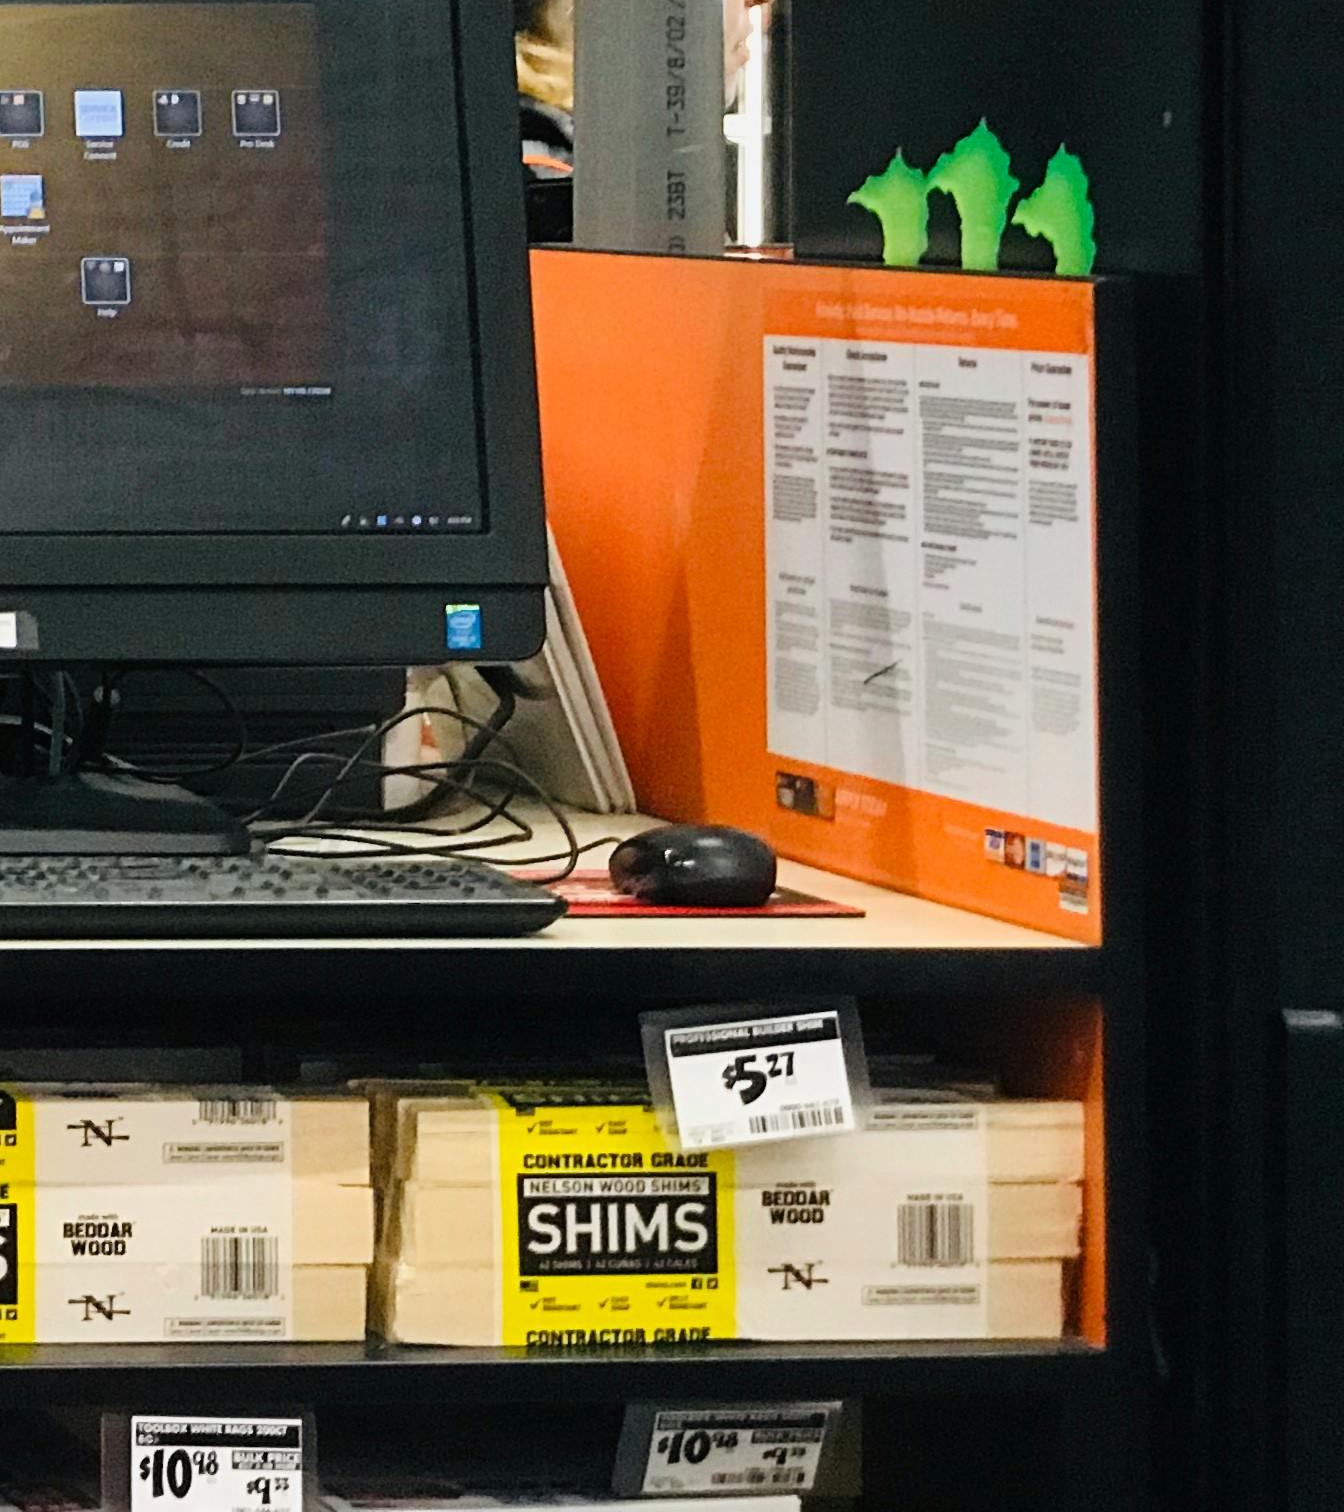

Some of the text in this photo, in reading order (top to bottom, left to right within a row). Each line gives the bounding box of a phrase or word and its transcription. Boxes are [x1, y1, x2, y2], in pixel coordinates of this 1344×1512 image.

[522, 1152, 710, 1170] CONTRACTOR GRADE
[529, 1178, 702, 1194] NELSON WOOD SHIMS
[761, 1190, 830, 1206] BEDDAR
[769, 1207, 825, 1224] WOOD
[63, 1222, 133, 1238] BEDDAR
[527, 1201, 709, 1255] SHIMS
[71, 1239, 127, 1256] WOOD
[525, 1327, 711, 1347] CONTRACTOR GRADE
[137, 1422, 188, 1434] TOOLBOX
[190, 1423, 222, 1435] WHITE
